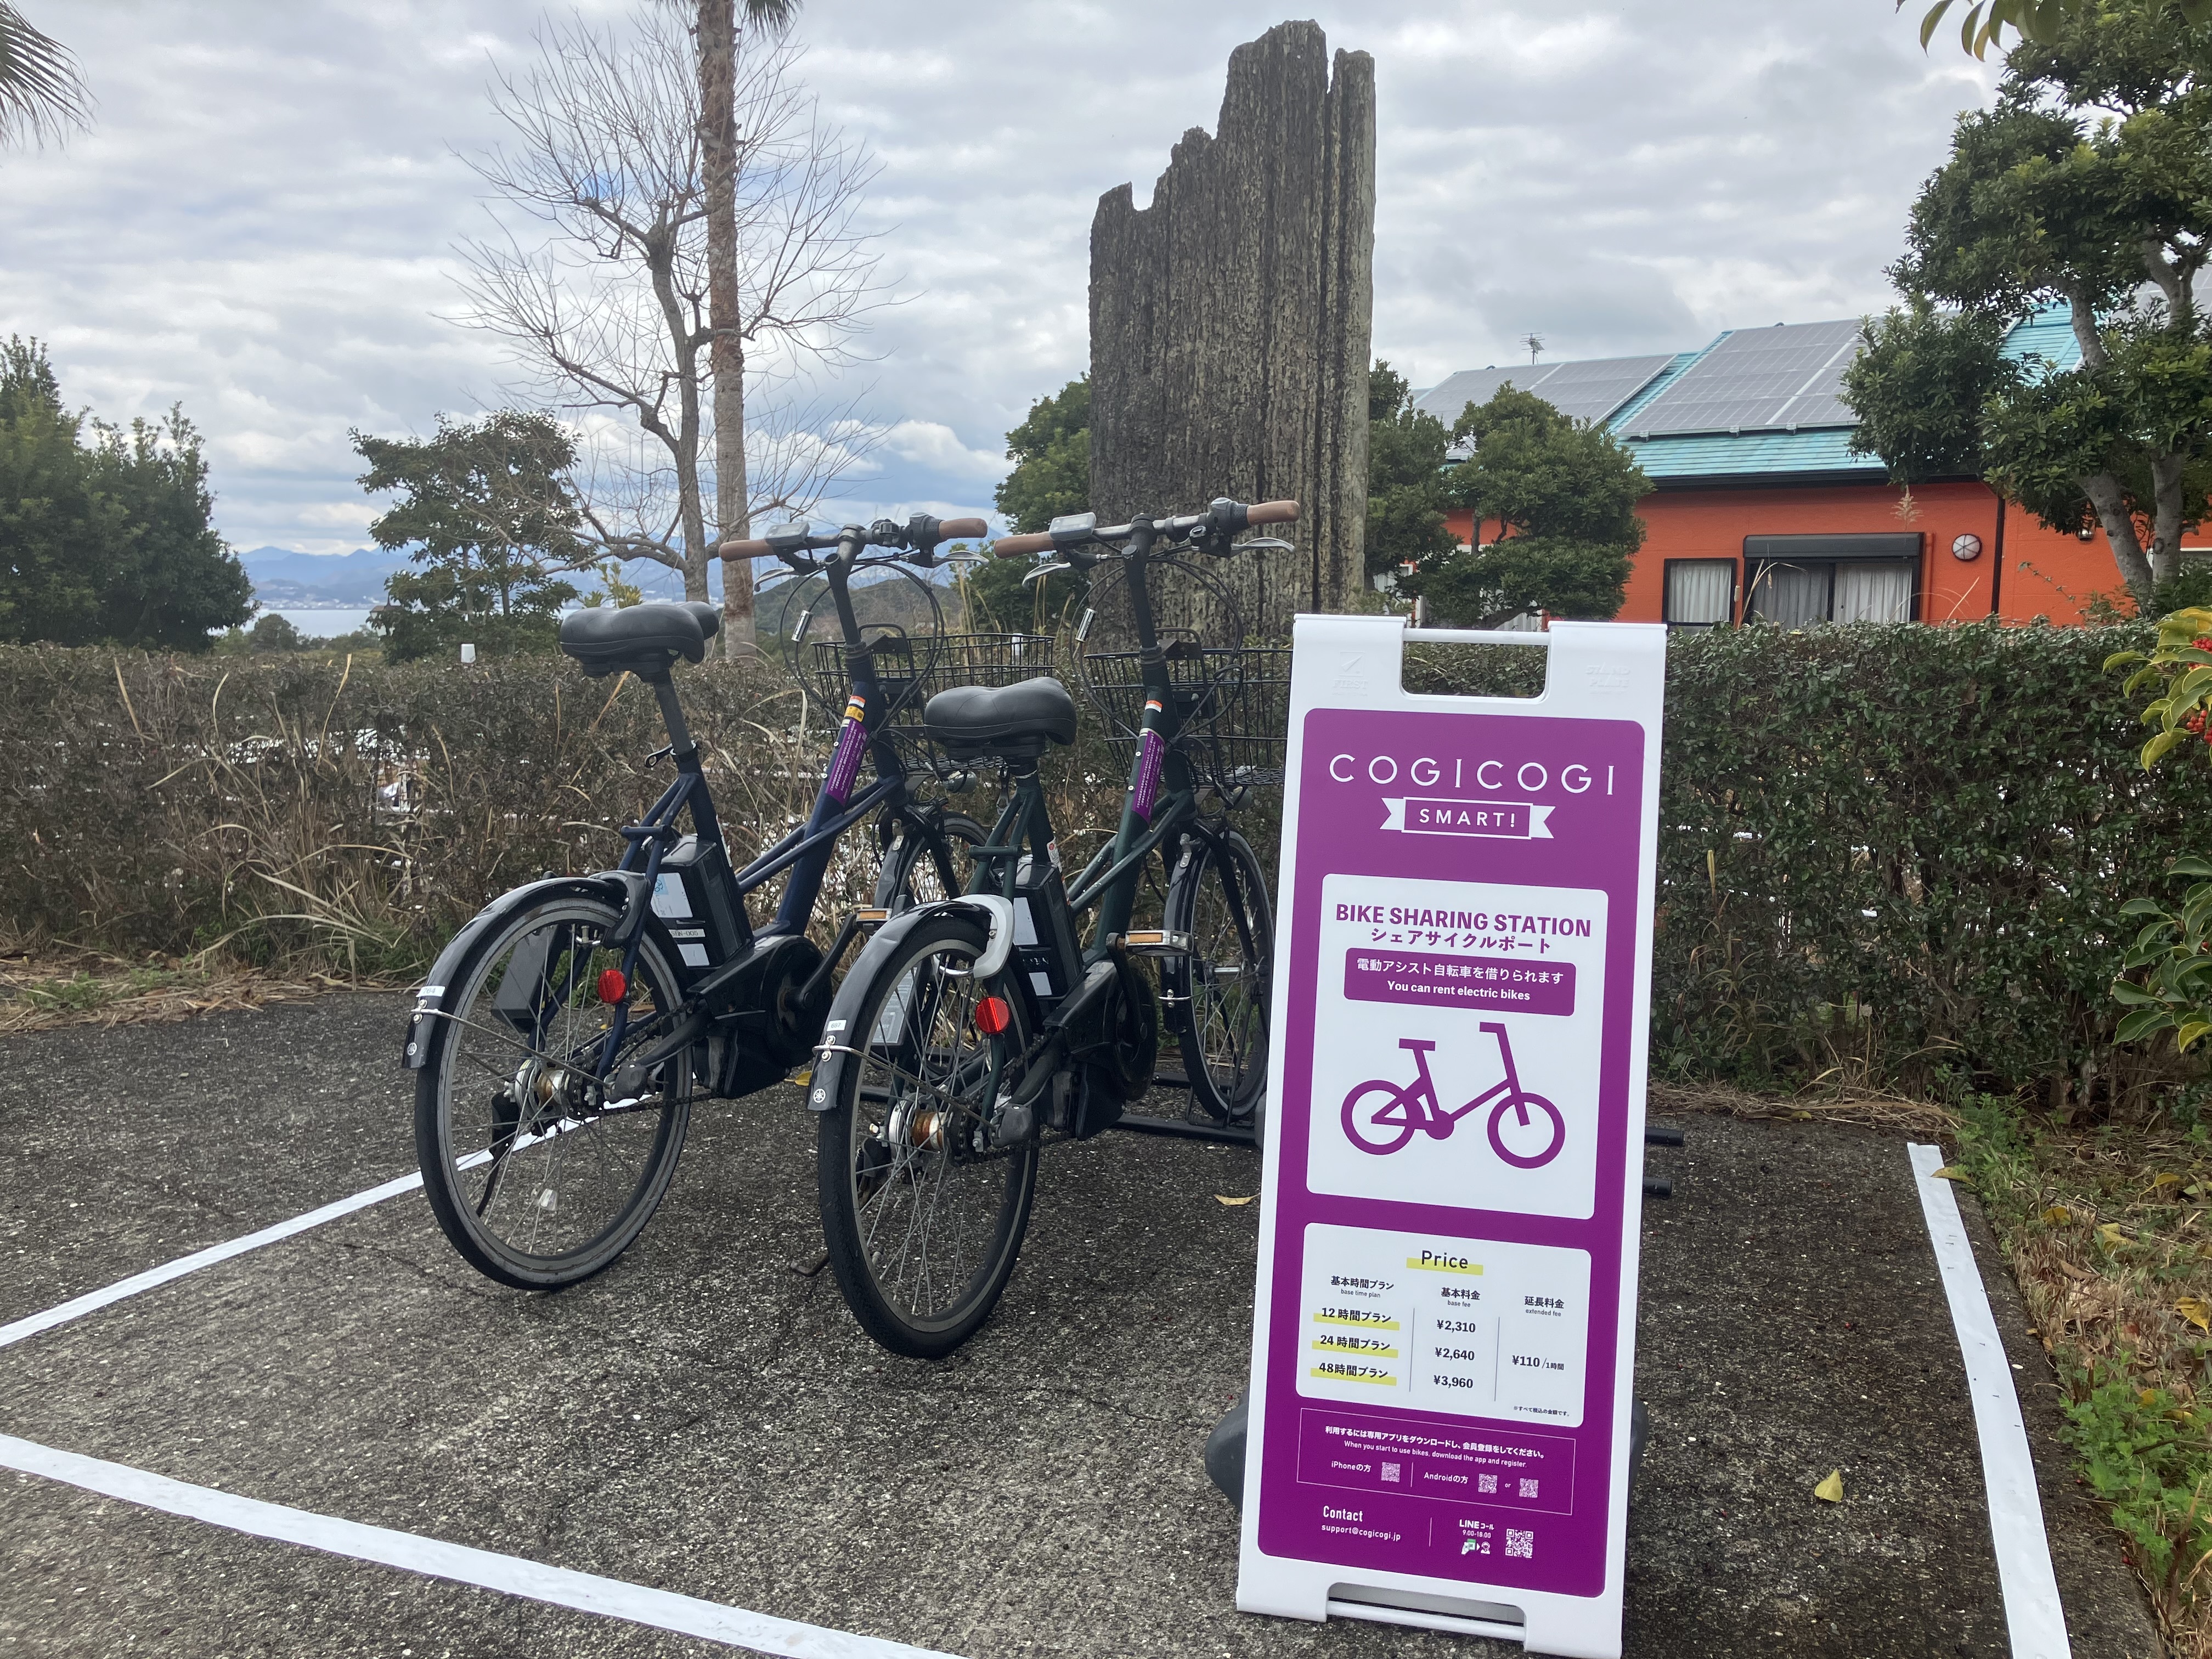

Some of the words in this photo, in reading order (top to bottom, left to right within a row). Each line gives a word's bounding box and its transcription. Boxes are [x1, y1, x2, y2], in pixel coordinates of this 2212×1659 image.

[1329, 754, 1614, 794] COGICOGI
[1419, 809, 1515, 827] SMART!
[1336, 904, 1384, 924] BIKE
[1389, 908, 1488, 930] SHARING
[1493, 913, 1591, 937] STATION
[1372, 928, 1550, 954] シェアサイクルポート
[1357, 958, 1564, 985] 電動アシスト自転車を借りられます
[1387, 980, 1408, 991] You
[1411, 984, 1431, 993] can
[1433, 985, 1455, 995] rent
[1457, 986, 1498, 998] electric
[1500, 989, 1531, 1001] bikes
[1421, 1250, 1469, 1269] Price
[1330, 1276, 1394, 1290] 基本時間プラン
[1441, 1287, 1481, 1300] 基本料金
[1524, 1296, 1565, 1309] 延長料金
[1436, 1319, 1476, 1333] ¥2,310
[1435, 1347, 1475, 1361] ¥2,640
[1318, 1362, 1389, 1378] 48時間プラン
[1434, 1374, 1474, 1389] ¥3,960
[1344, 1440, 1362, 1448] When
[1432, 1451, 1462, 1460] download
[1331, 1460, 1372, 1472] iPhoneの方
[1424, 1472, 1469, 1485] Androidの方
[1323, 1505, 1363, 1522] Contact
[1321, 1525, 1401, 1542] support@cogicogi.jp
